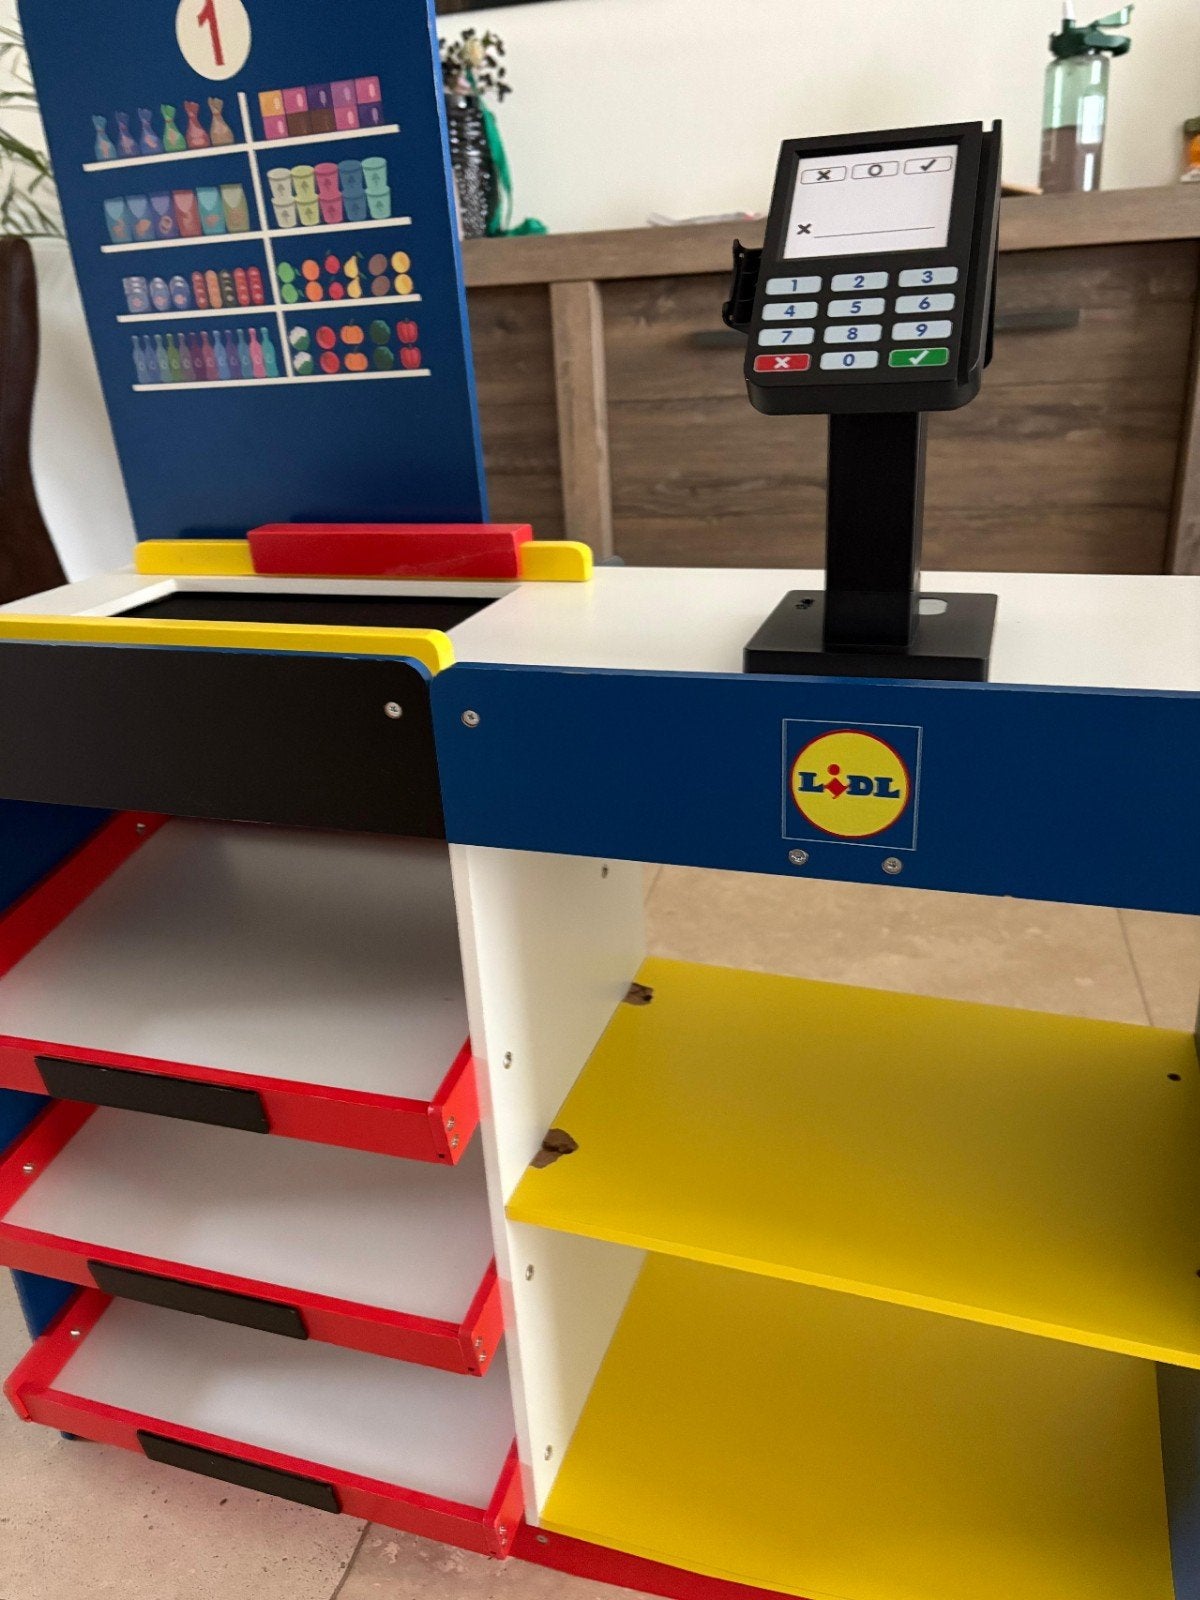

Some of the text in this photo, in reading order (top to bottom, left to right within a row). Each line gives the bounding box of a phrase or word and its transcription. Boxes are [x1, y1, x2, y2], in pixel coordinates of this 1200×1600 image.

[197, 0, 225, 66] 1
[791, 270, 934, 292] 1 2 3
[783, 297, 931, 318] 4 5 6
[781, 323, 929, 344] 7 8 9
[842, 353, 856, 367] 0
